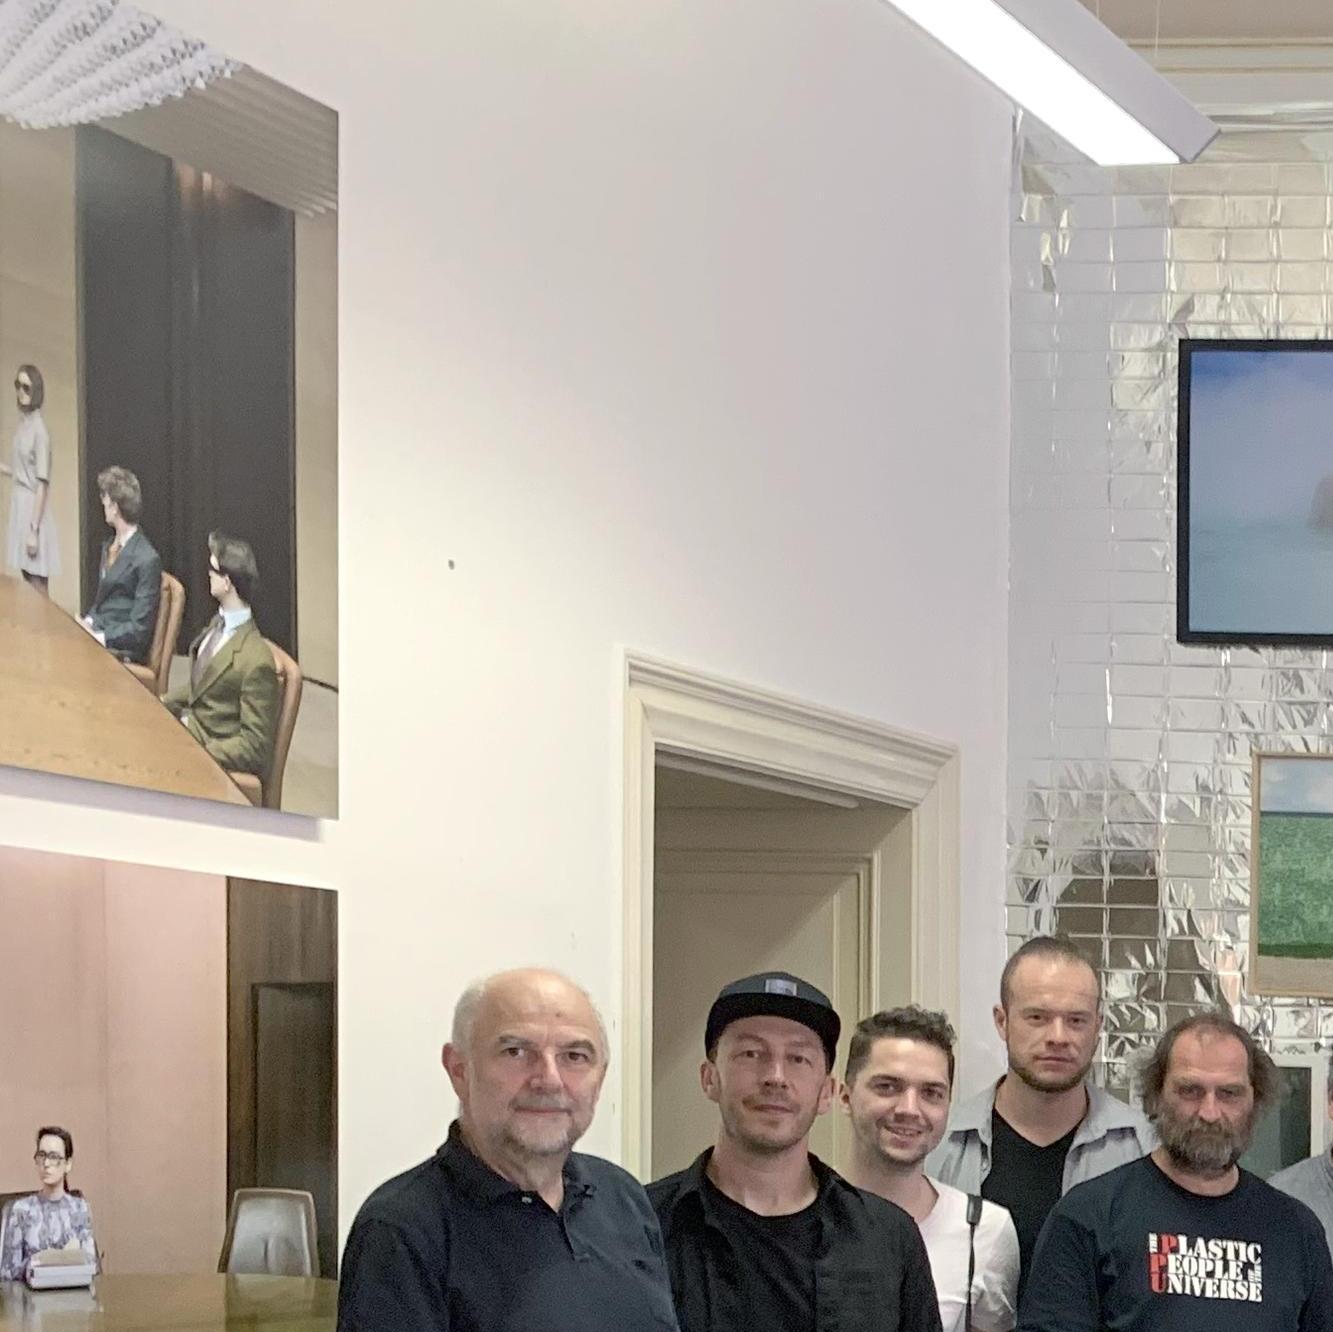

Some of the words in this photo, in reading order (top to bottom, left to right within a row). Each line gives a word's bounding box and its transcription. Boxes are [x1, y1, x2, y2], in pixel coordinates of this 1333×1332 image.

[1160, 1232, 1261, 1264] PLASTIC
[1149, 1253, 1243, 1281] PEOPLE
[1150, 1272, 1263, 1302] UNIVERSE
